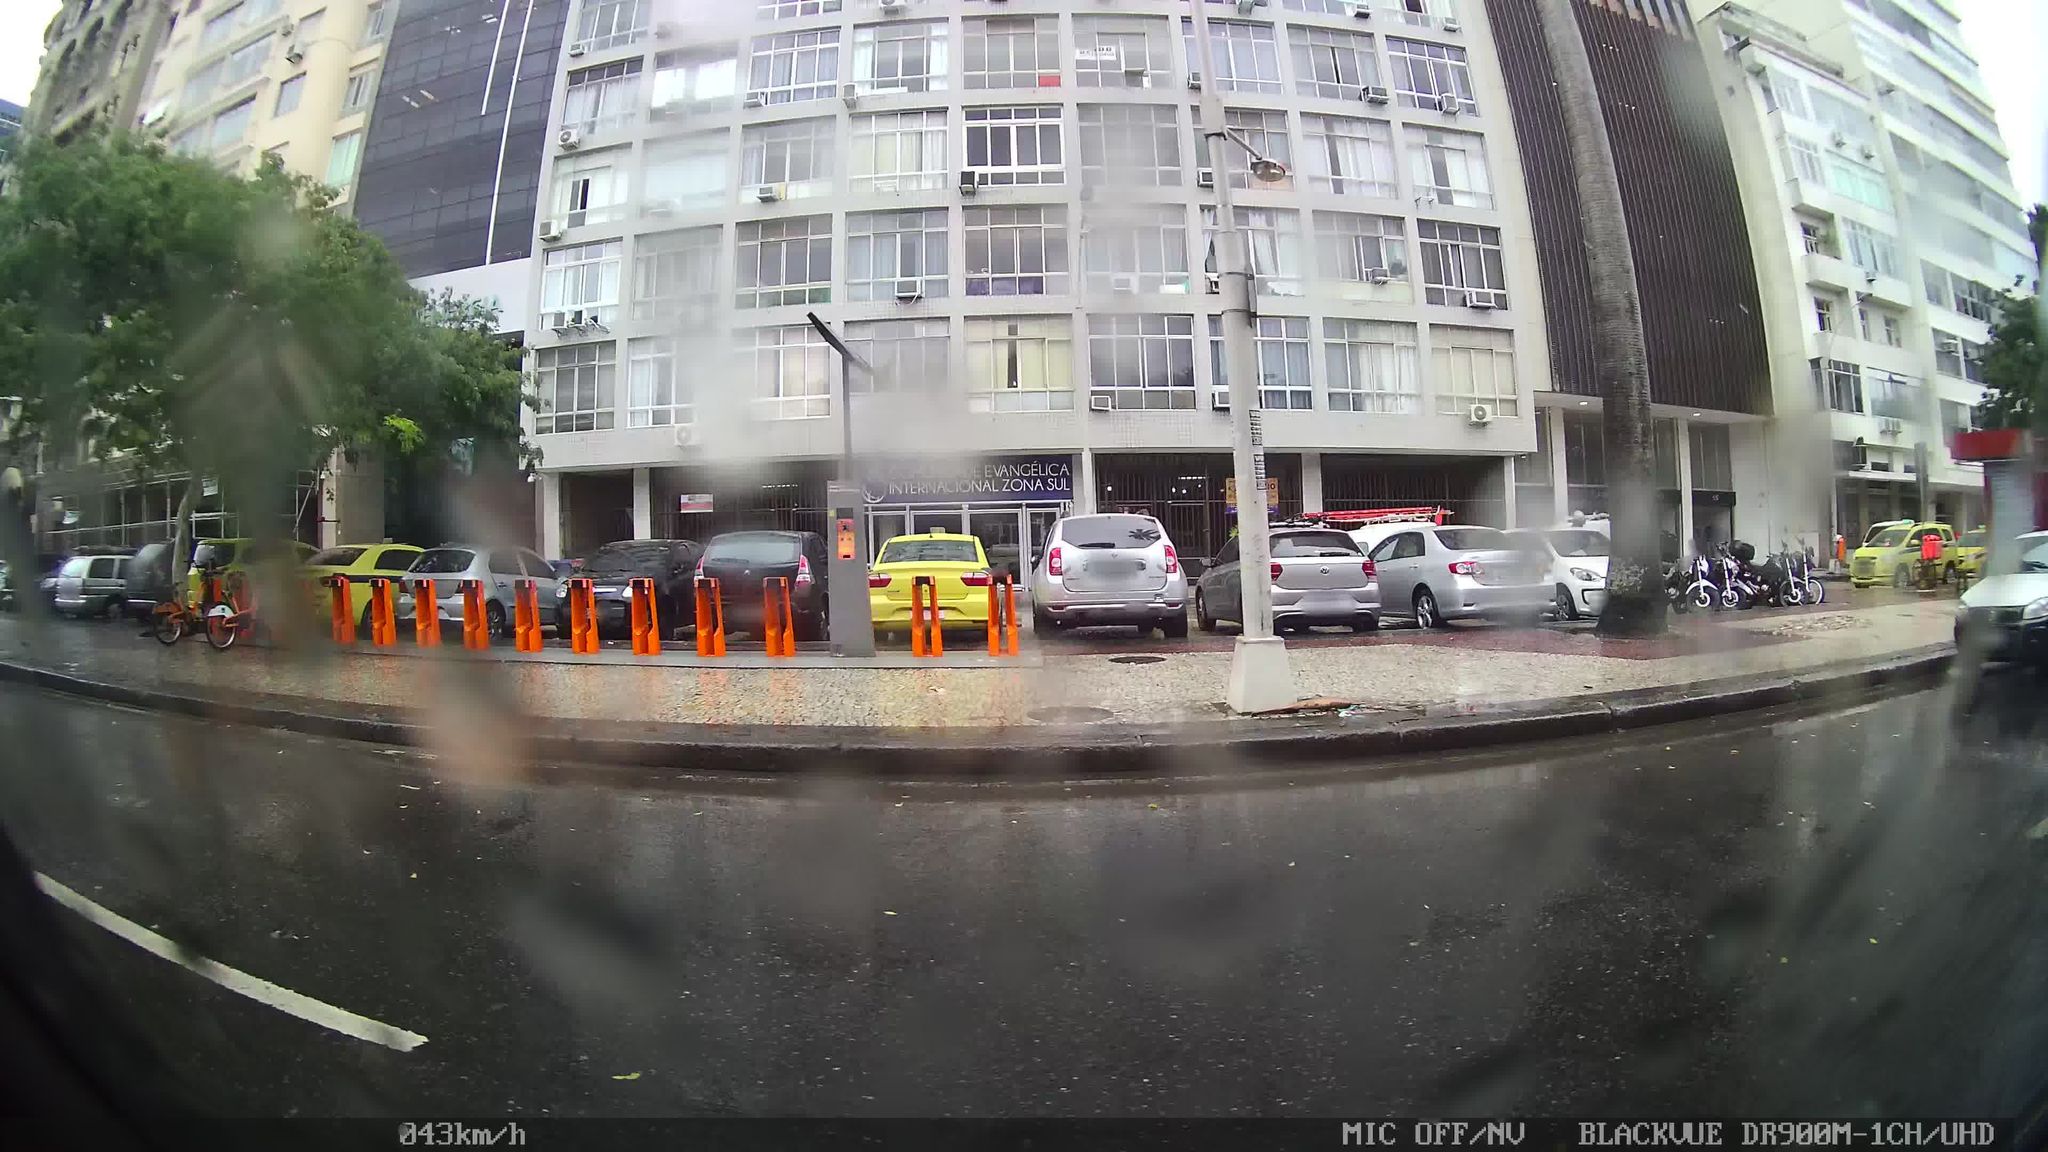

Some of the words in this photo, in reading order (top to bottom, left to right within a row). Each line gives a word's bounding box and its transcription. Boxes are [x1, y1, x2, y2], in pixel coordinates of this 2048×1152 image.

[984, 461, 1070, 478] EVANGÉLICA
[889, 478, 999, 495] INTERNACIONAL
[1001, 478, 1044, 492] ZONA
[1046, 478, 1071, 492] SUL
